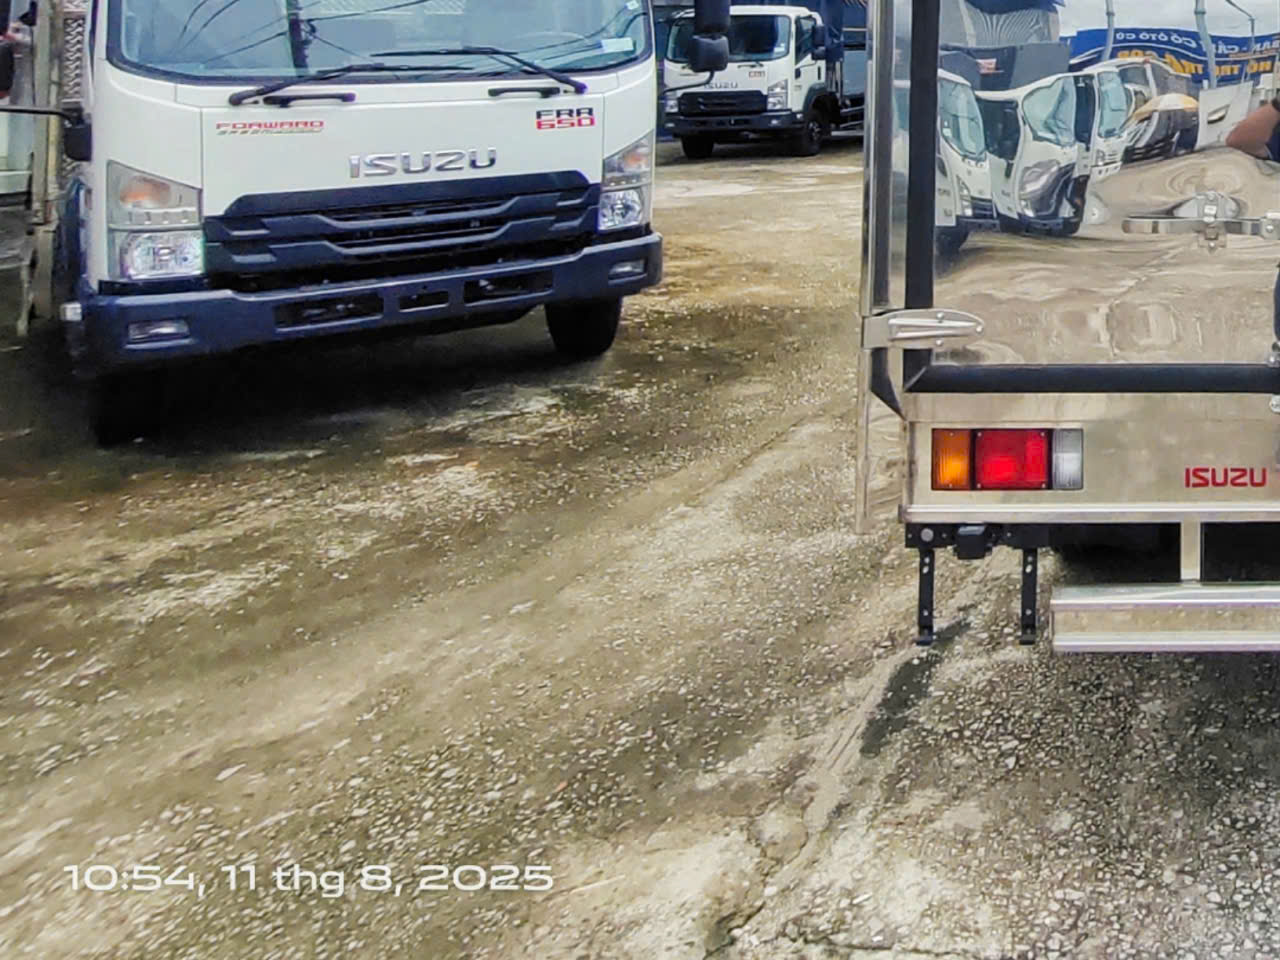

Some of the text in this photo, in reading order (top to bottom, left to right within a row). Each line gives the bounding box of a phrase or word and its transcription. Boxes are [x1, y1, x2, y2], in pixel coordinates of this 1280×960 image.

[536, 107, 593, 119] FRR
[536, 117, 595, 130] 650
[349, 147, 497, 179] ISUZU
[1184, 467, 1267, 488] ISUZU
